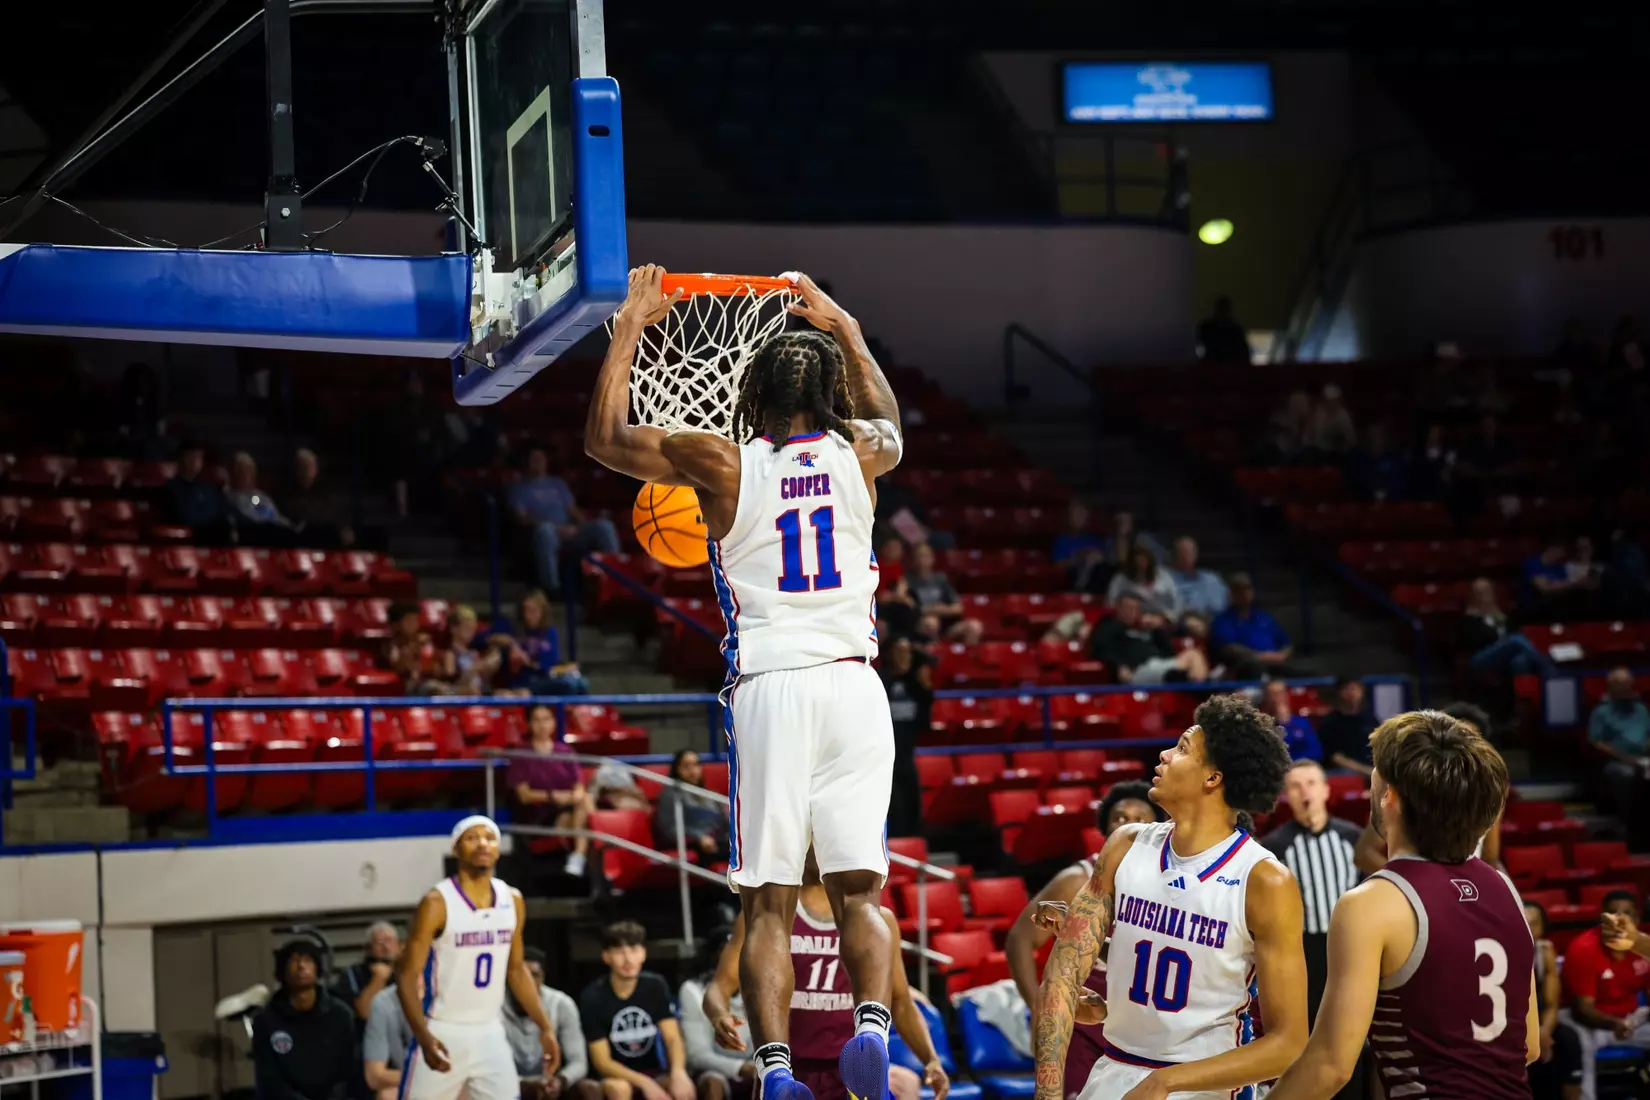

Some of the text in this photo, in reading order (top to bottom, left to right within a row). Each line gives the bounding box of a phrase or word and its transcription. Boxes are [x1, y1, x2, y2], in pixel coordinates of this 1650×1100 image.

[1548, 226, 1603, 260] 101
[780, 473, 831, 500] COOPER
[775, 505, 842, 592] 11
[1117, 893, 1229, 949] LOUISIANA TECH
[474, 952, 493, 988] 0
[805, 957, 840, 991] 11
[1128, 939, 1193, 1013] 10
[1471, 937, 1509, 1042] 3
